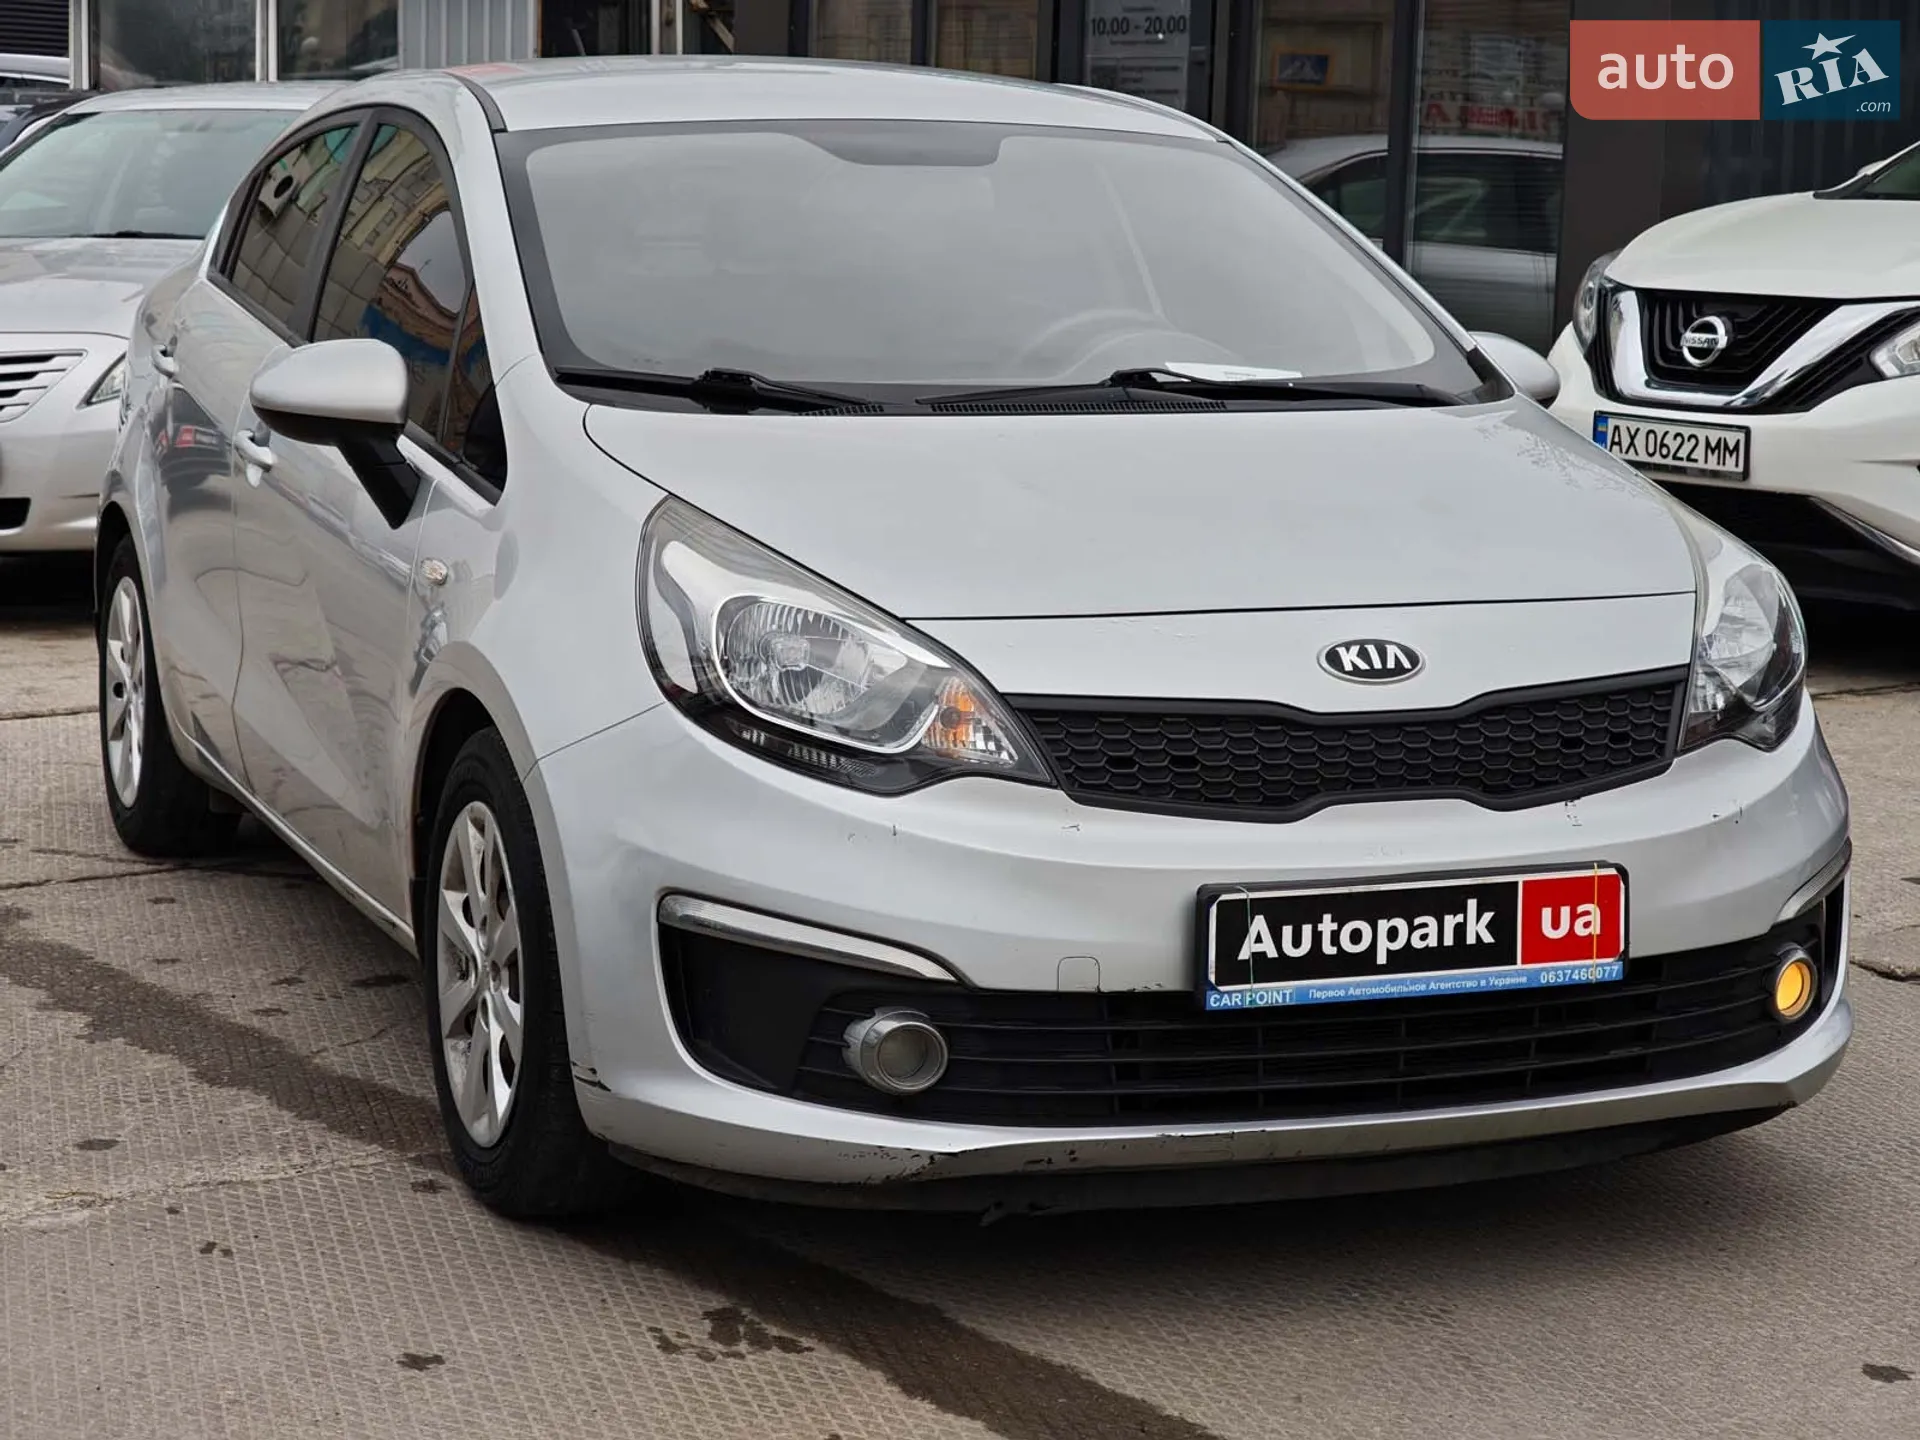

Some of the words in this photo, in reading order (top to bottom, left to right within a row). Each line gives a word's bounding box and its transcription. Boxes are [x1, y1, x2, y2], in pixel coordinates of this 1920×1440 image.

[1682, 335, 1720, 347] NISSAN
[1609, 424, 1640, 457] AX
[1645, 429, 1699, 463] 0622
[1704, 435, 1740, 469] MM
[1335, 644, 1412, 672] KIA
[1237, 898, 1496, 965] Autopark
[1541, 903, 1601, 940] ua
[1309, 988, 1345, 1000] Первое
[1348, 983, 1426, 996] Автомобильное
